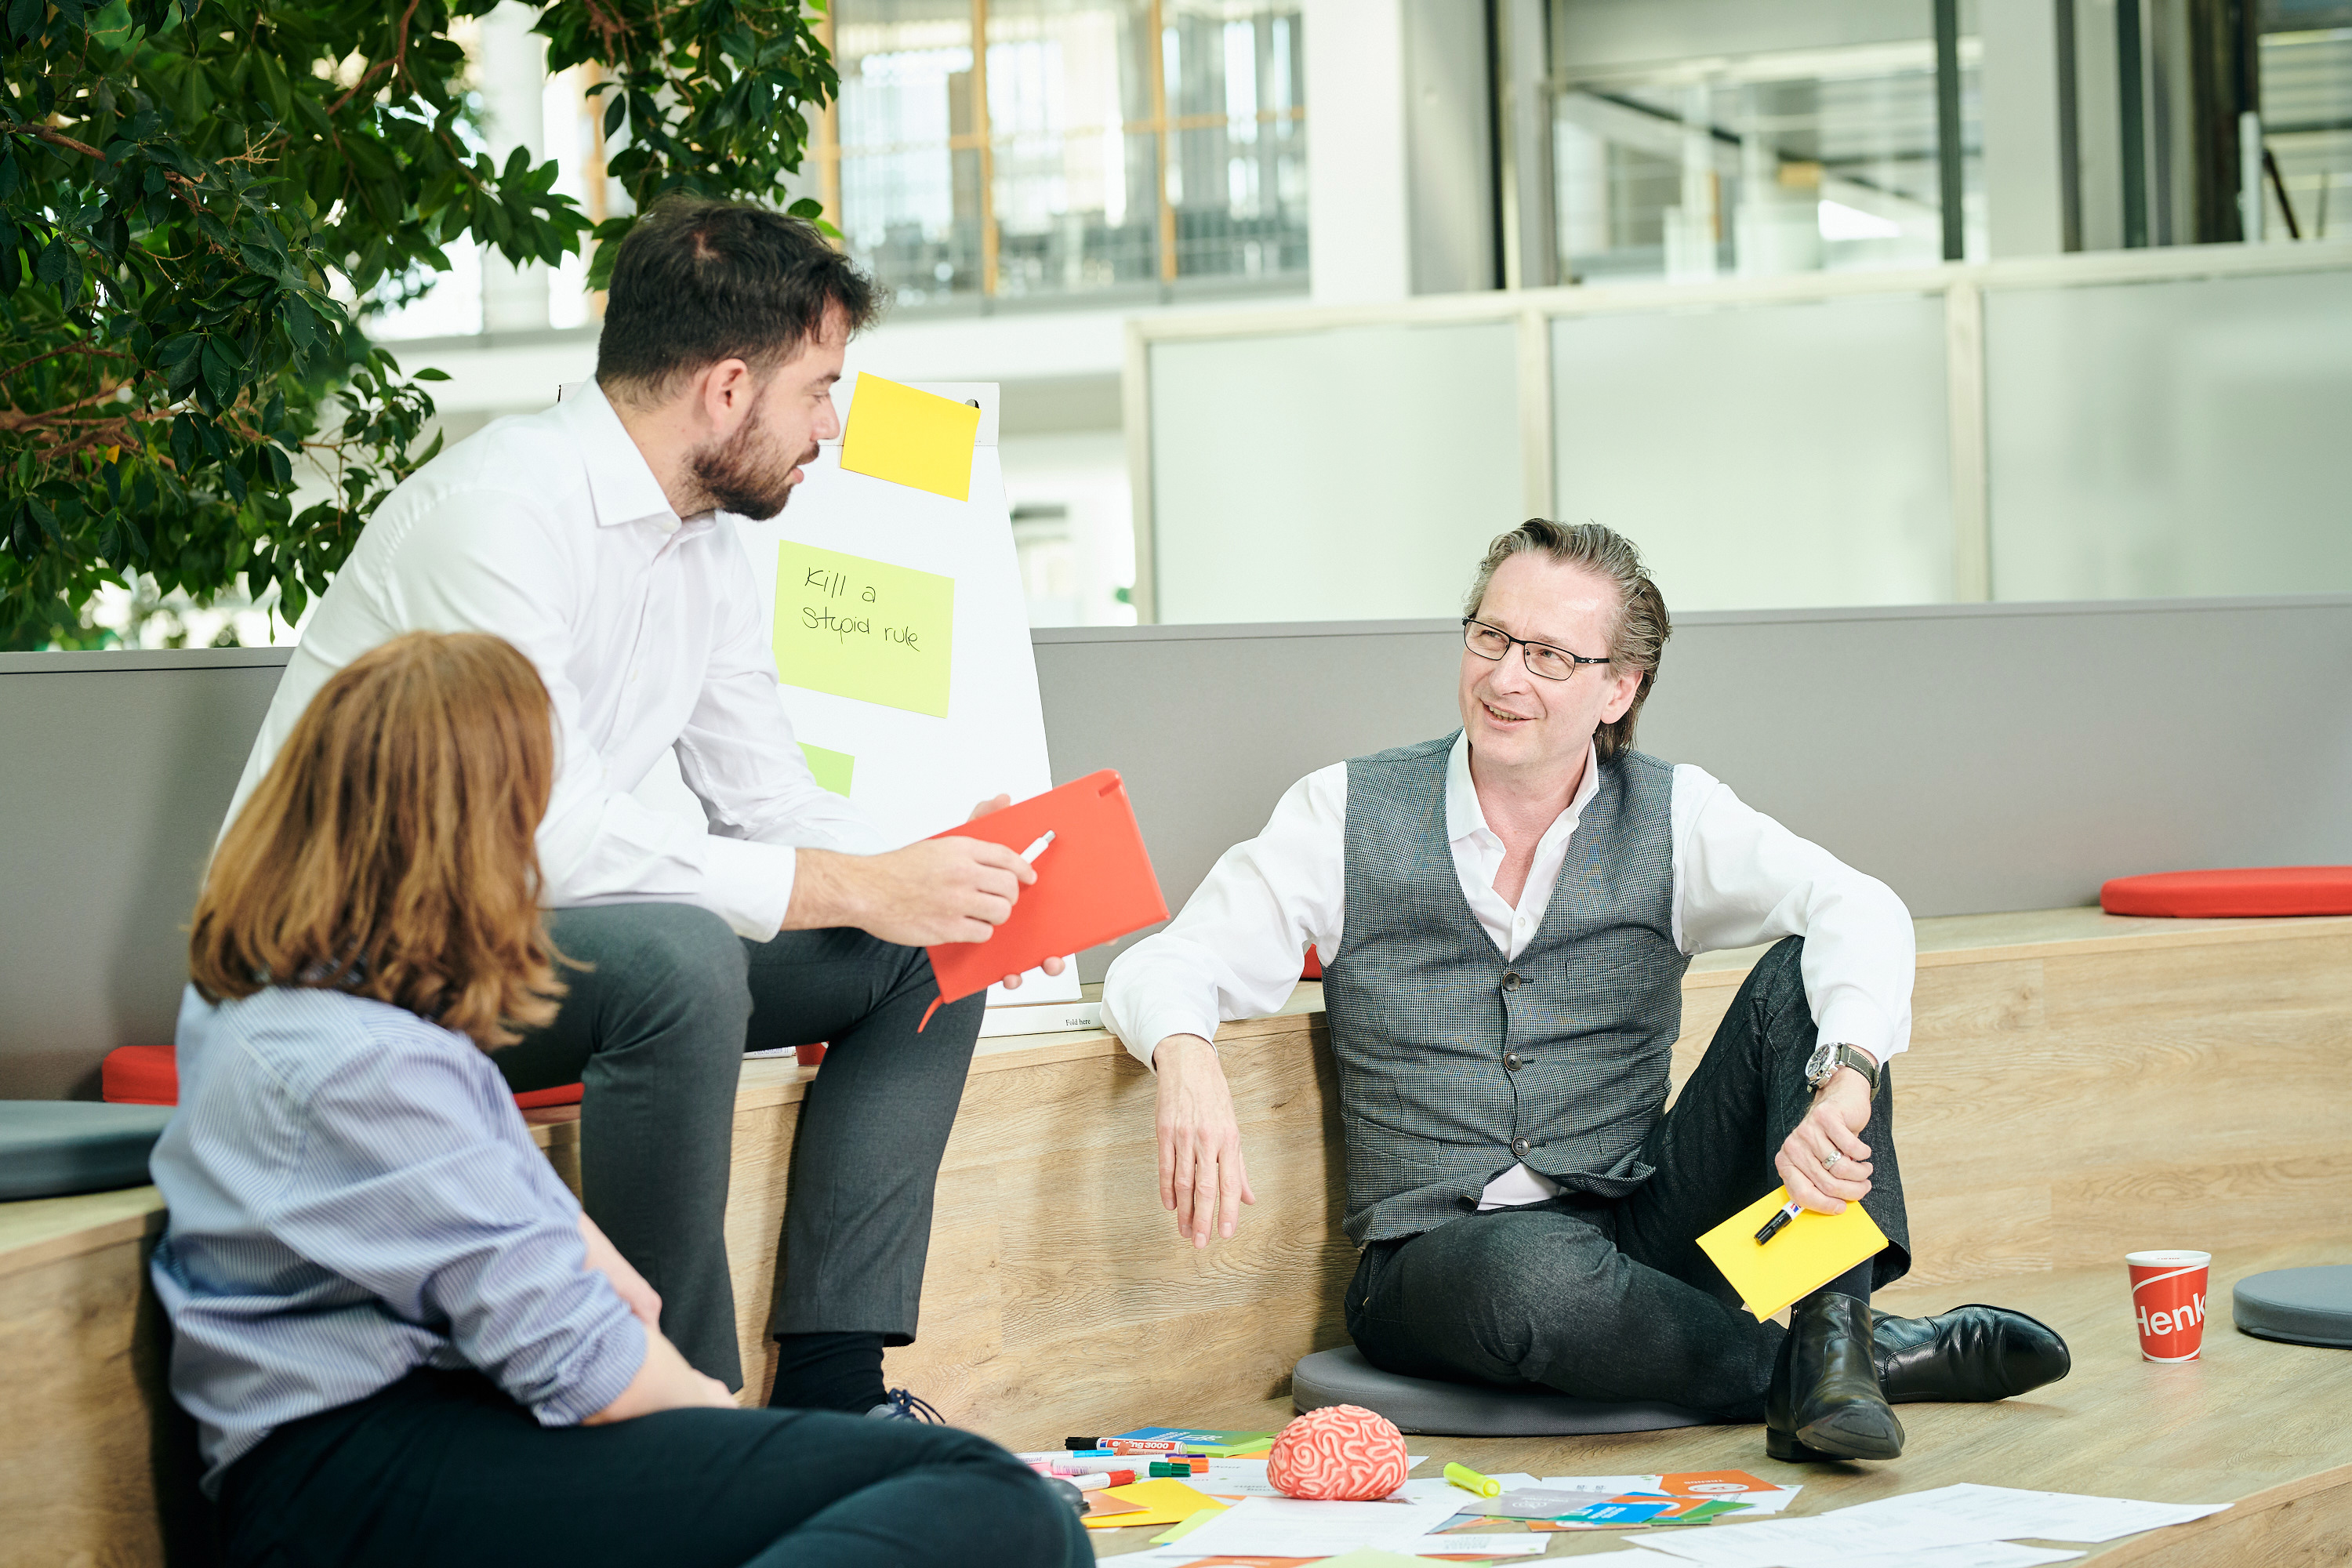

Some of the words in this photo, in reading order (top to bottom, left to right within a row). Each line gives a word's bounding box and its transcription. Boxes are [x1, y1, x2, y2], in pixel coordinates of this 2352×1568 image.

[805, 567, 846, 598] Kill
[862, 586, 876, 603] a
[884, 626, 920, 652] rule
